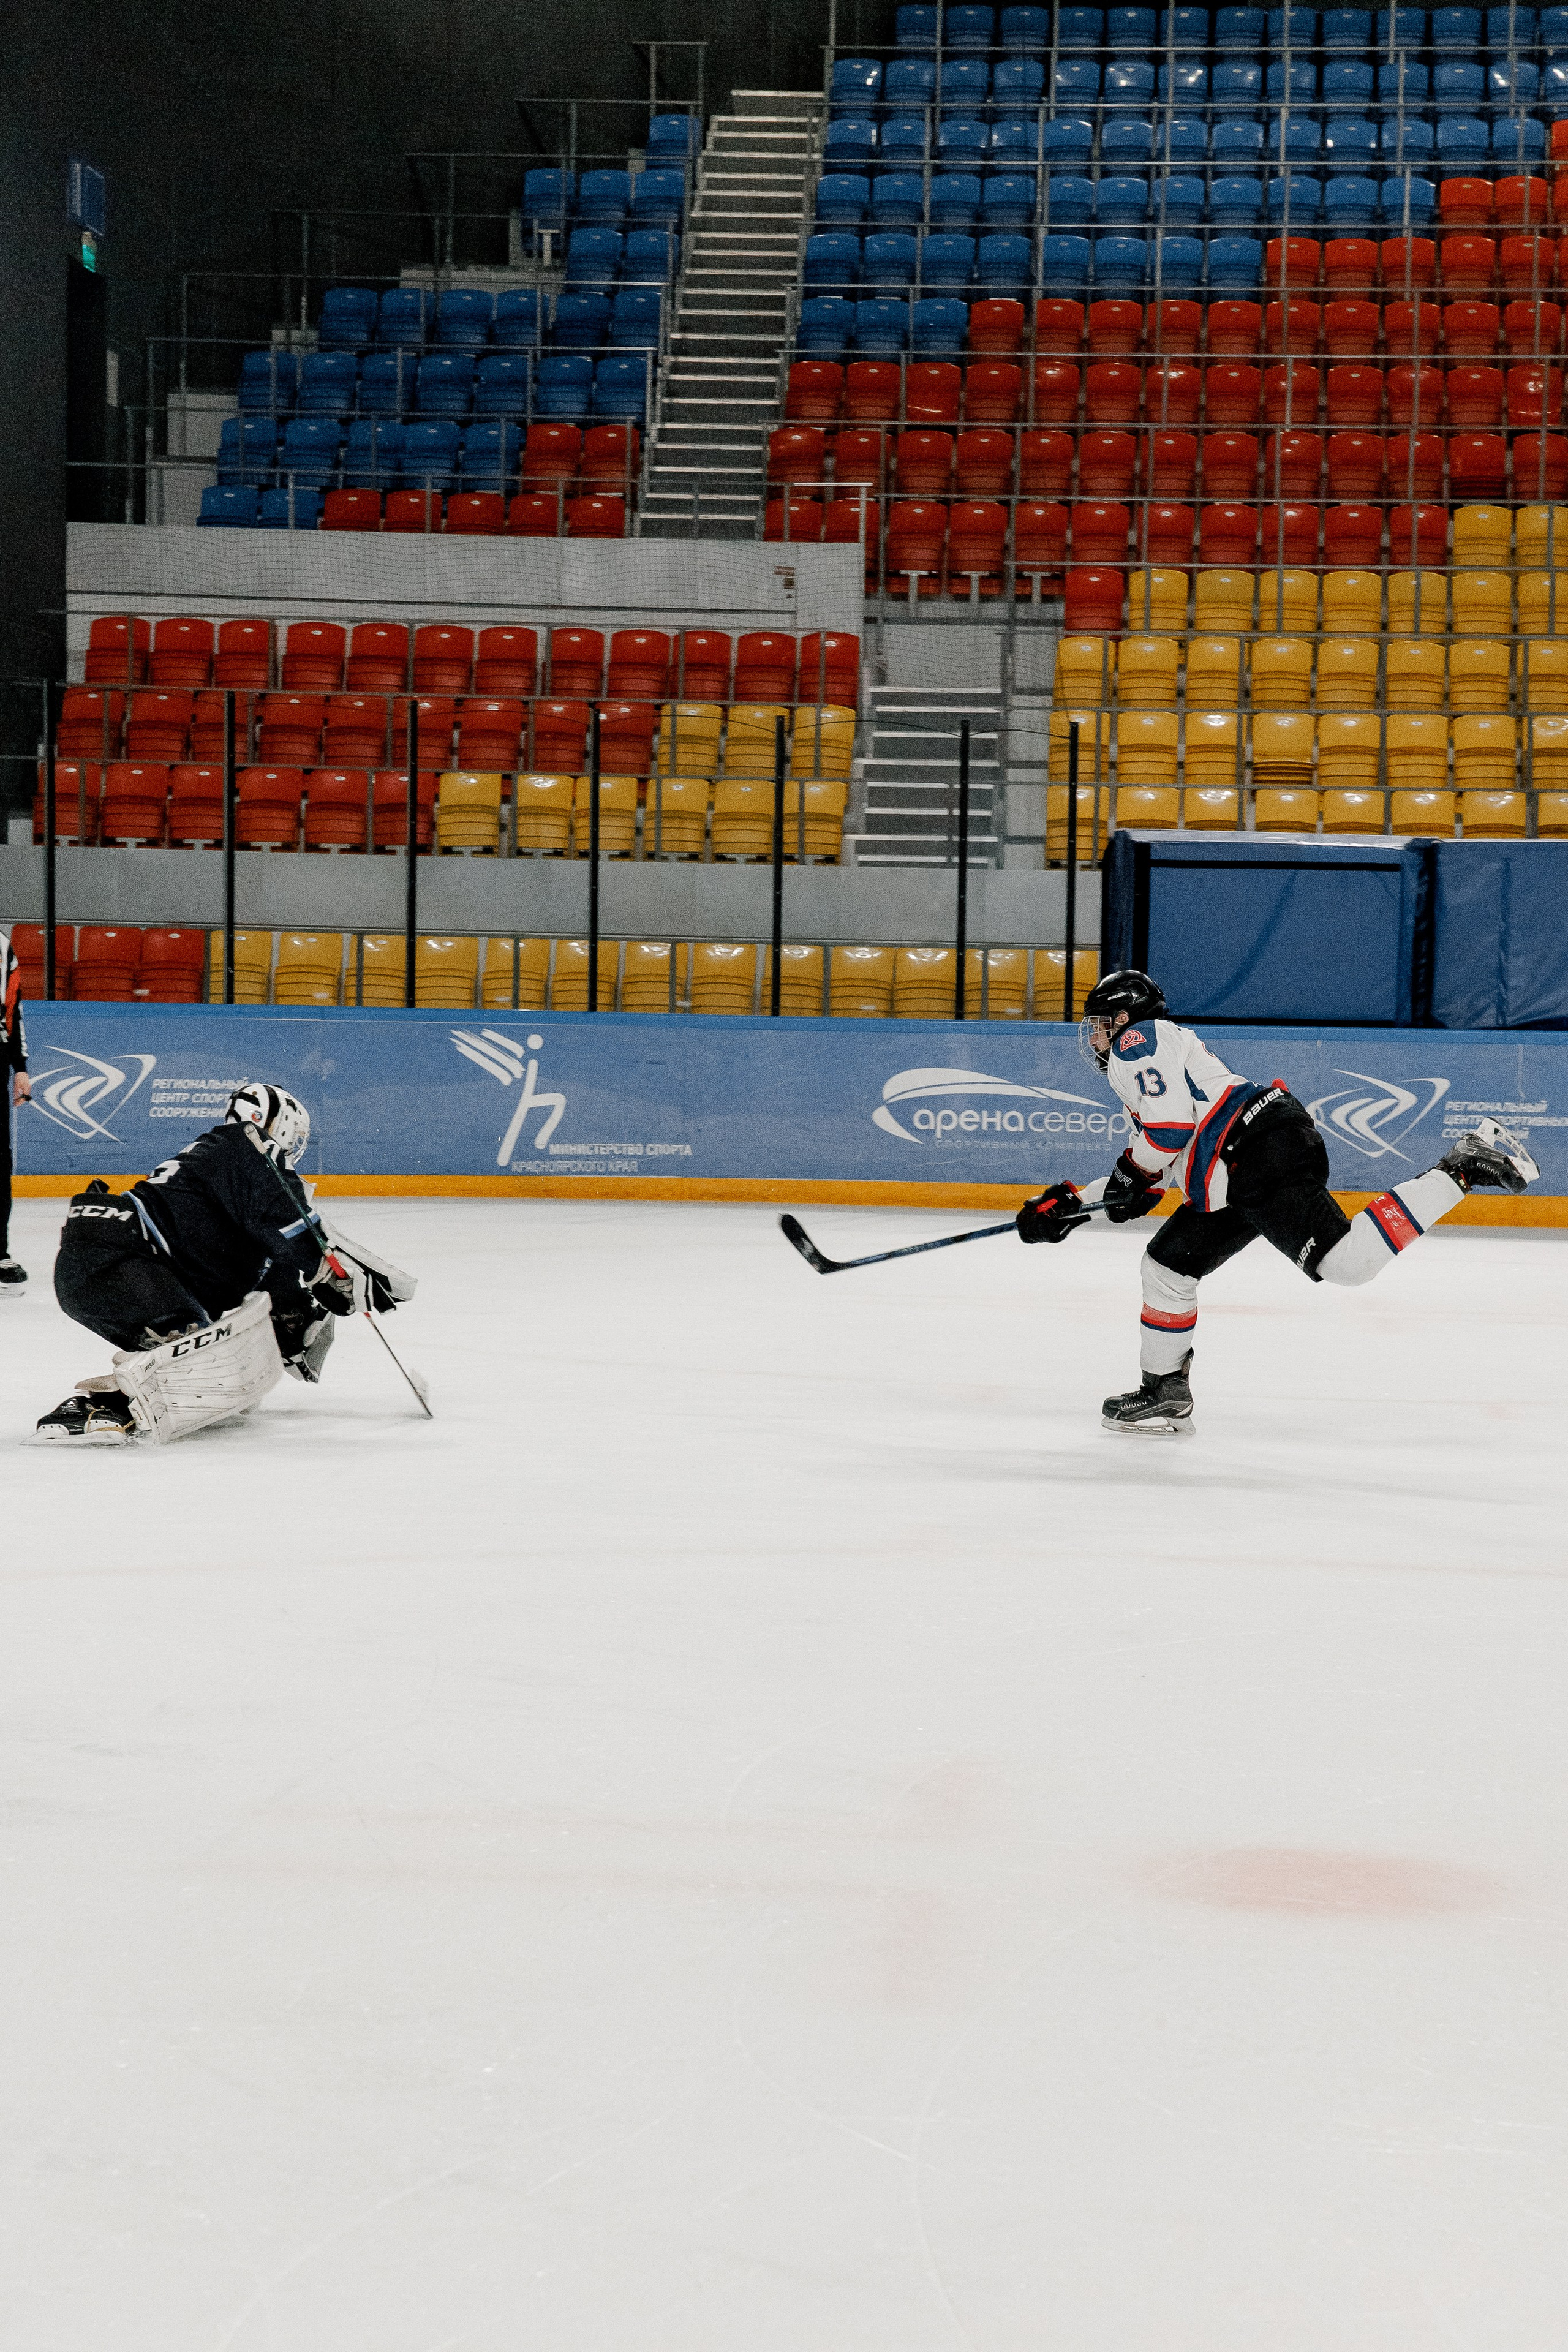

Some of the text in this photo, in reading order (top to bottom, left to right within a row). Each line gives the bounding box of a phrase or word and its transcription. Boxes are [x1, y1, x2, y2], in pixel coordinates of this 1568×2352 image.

[1134, 1067, 1168, 1098] 13
[151, 1093, 230, 1104] ЦЕНТР СПОРТ
[1242, 1088, 1284, 1125] BAUER
[1444, 1100, 1548, 1113] РЕГИОНАЛЬНЫЙ
[549, 1143, 693, 1156] МИНИСТЕРСТВО СПОРТА
[511, 1161, 638, 1172] КРАСНОЯРСКОГО КРАЯ
[68, 1205, 134, 1221] CCM
[171, 1322, 232, 1358] CCM
